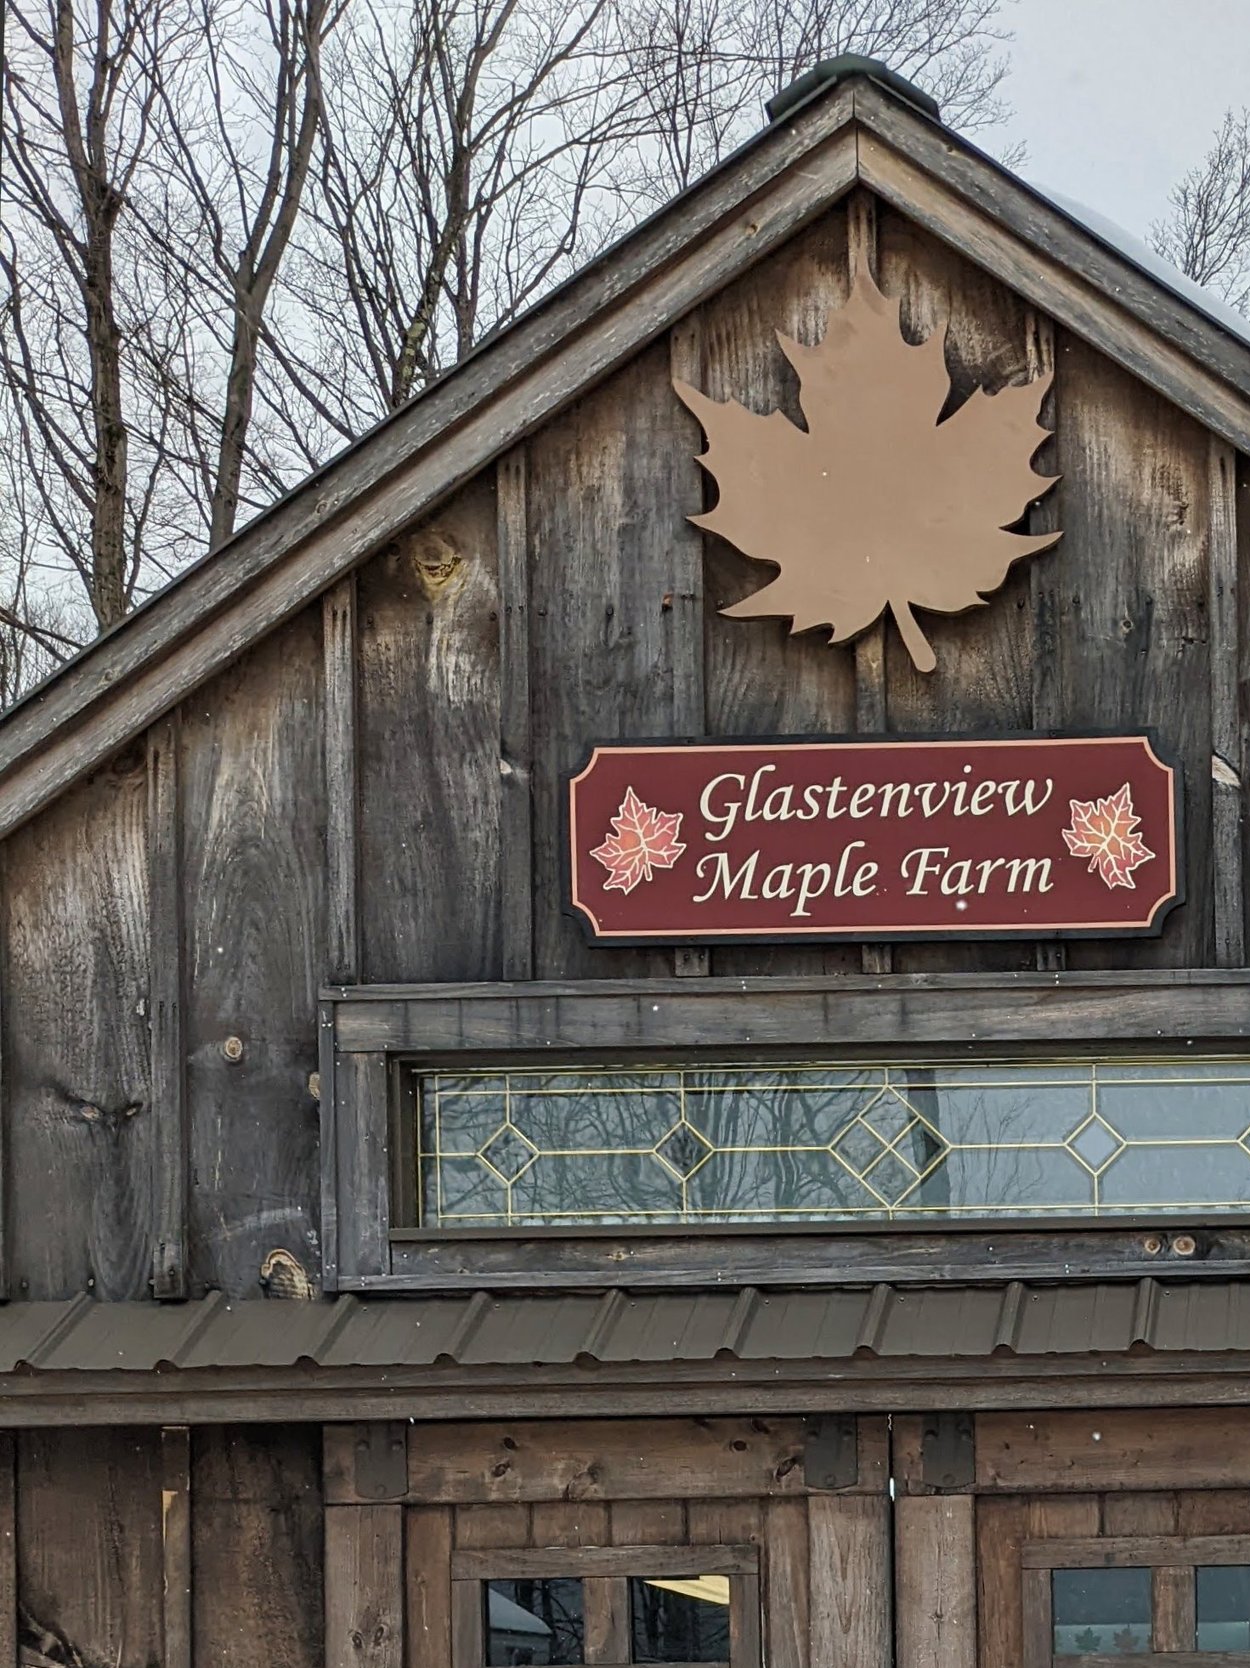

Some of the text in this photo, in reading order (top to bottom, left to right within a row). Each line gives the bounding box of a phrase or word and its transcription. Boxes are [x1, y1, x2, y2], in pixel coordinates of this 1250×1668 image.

[698, 764, 1054, 842] Glastenview
[692, 840, 1054, 917] Maple Farm
